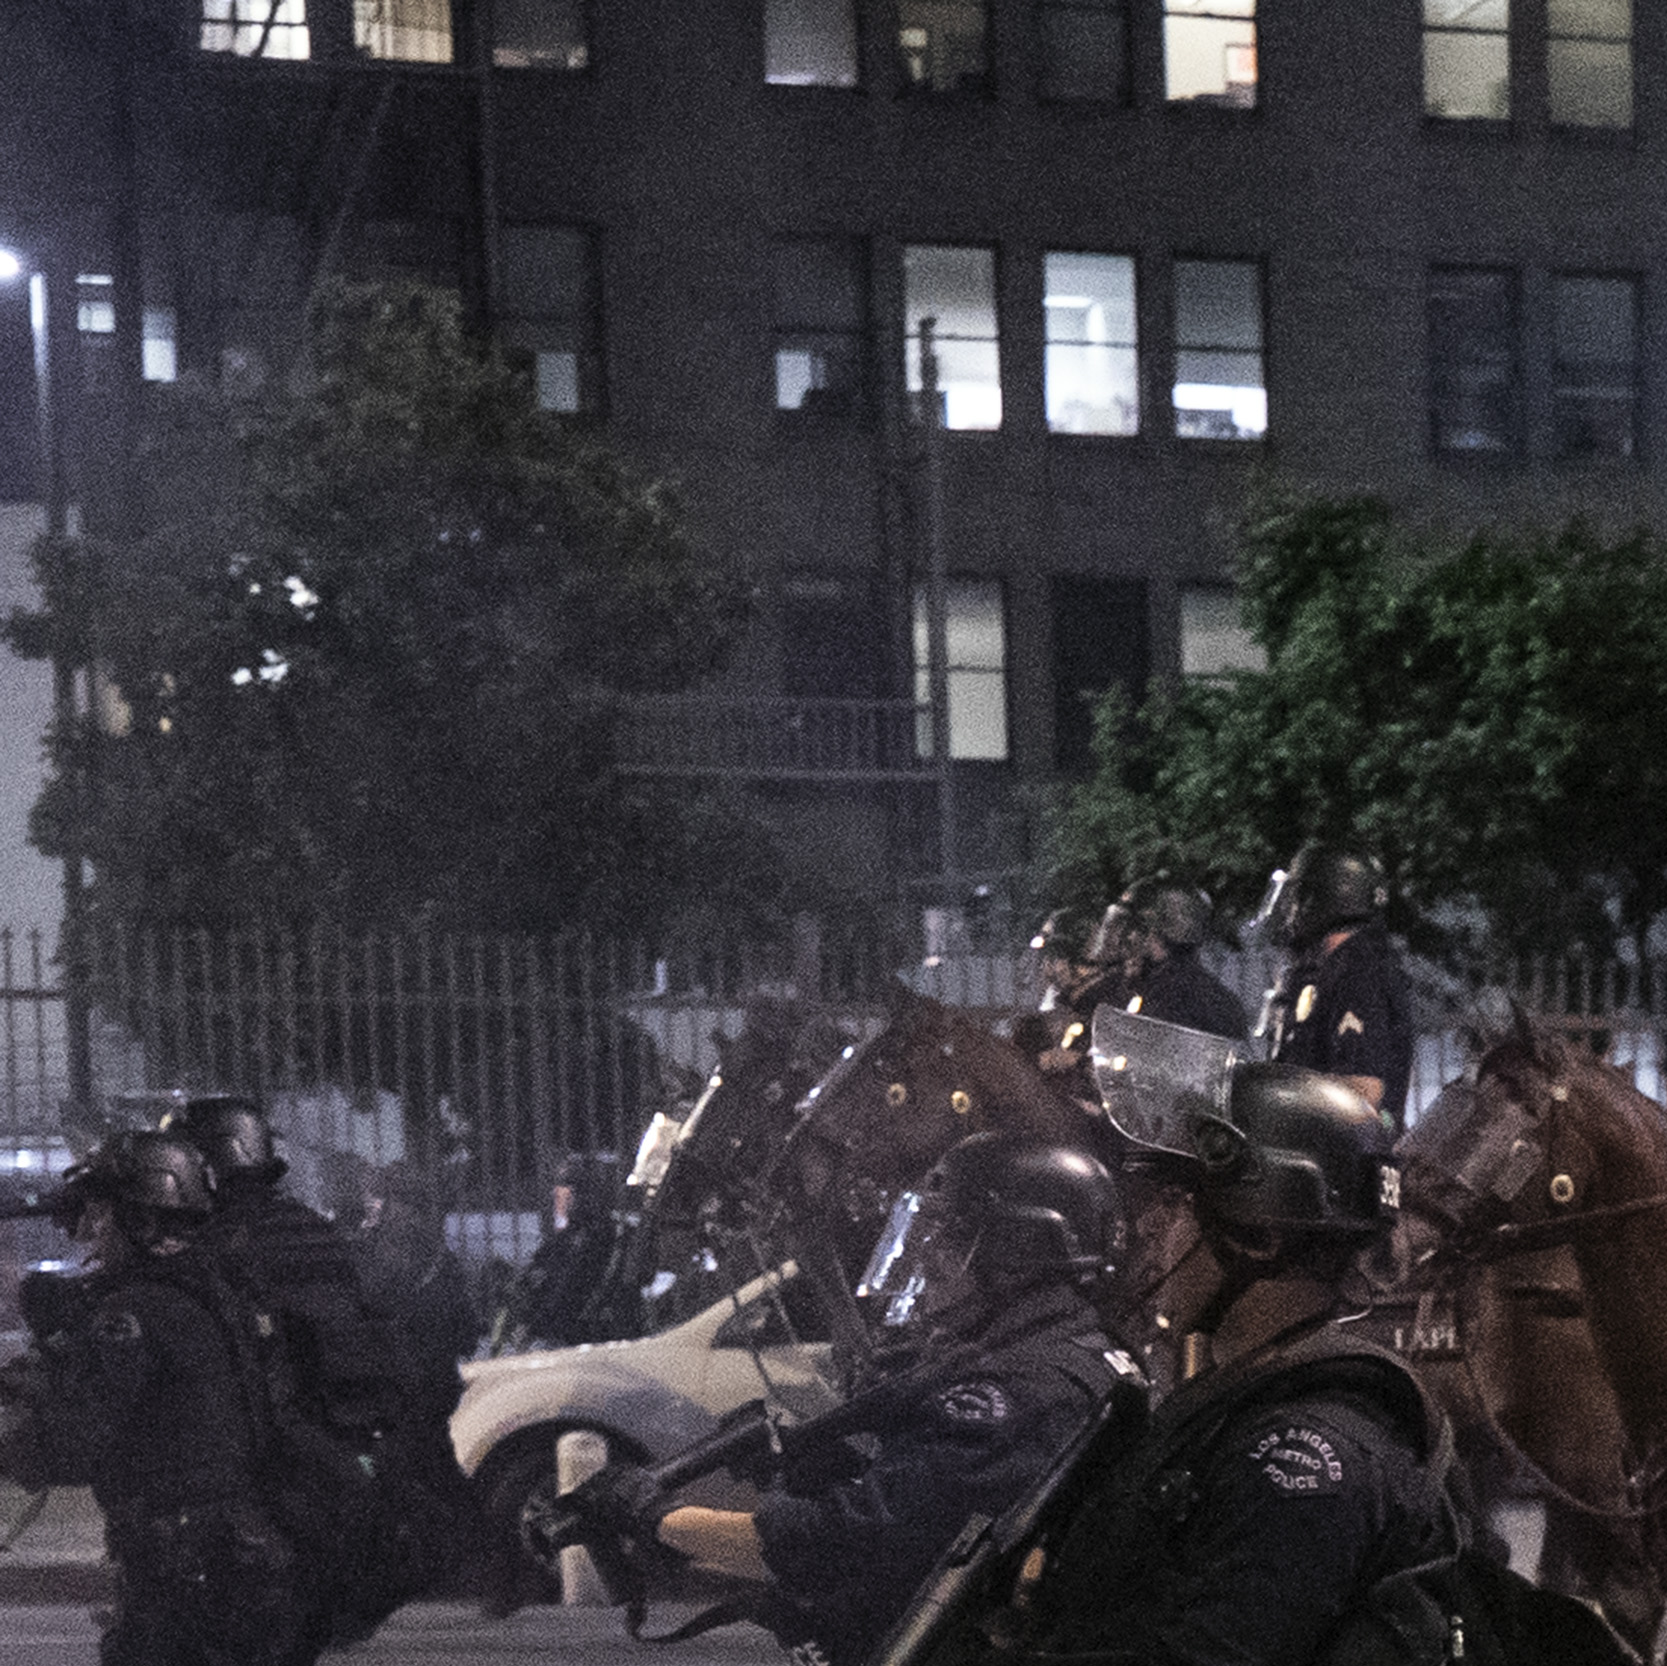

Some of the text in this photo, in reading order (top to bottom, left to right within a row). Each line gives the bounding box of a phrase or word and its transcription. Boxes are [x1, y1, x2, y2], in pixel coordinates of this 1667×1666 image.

[1248, 1427, 1343, 1482] LOS ANGELES
[1270, 1447, 1323, 1471] METRO
[1262, 1462, 1319, 1490] POLICE
